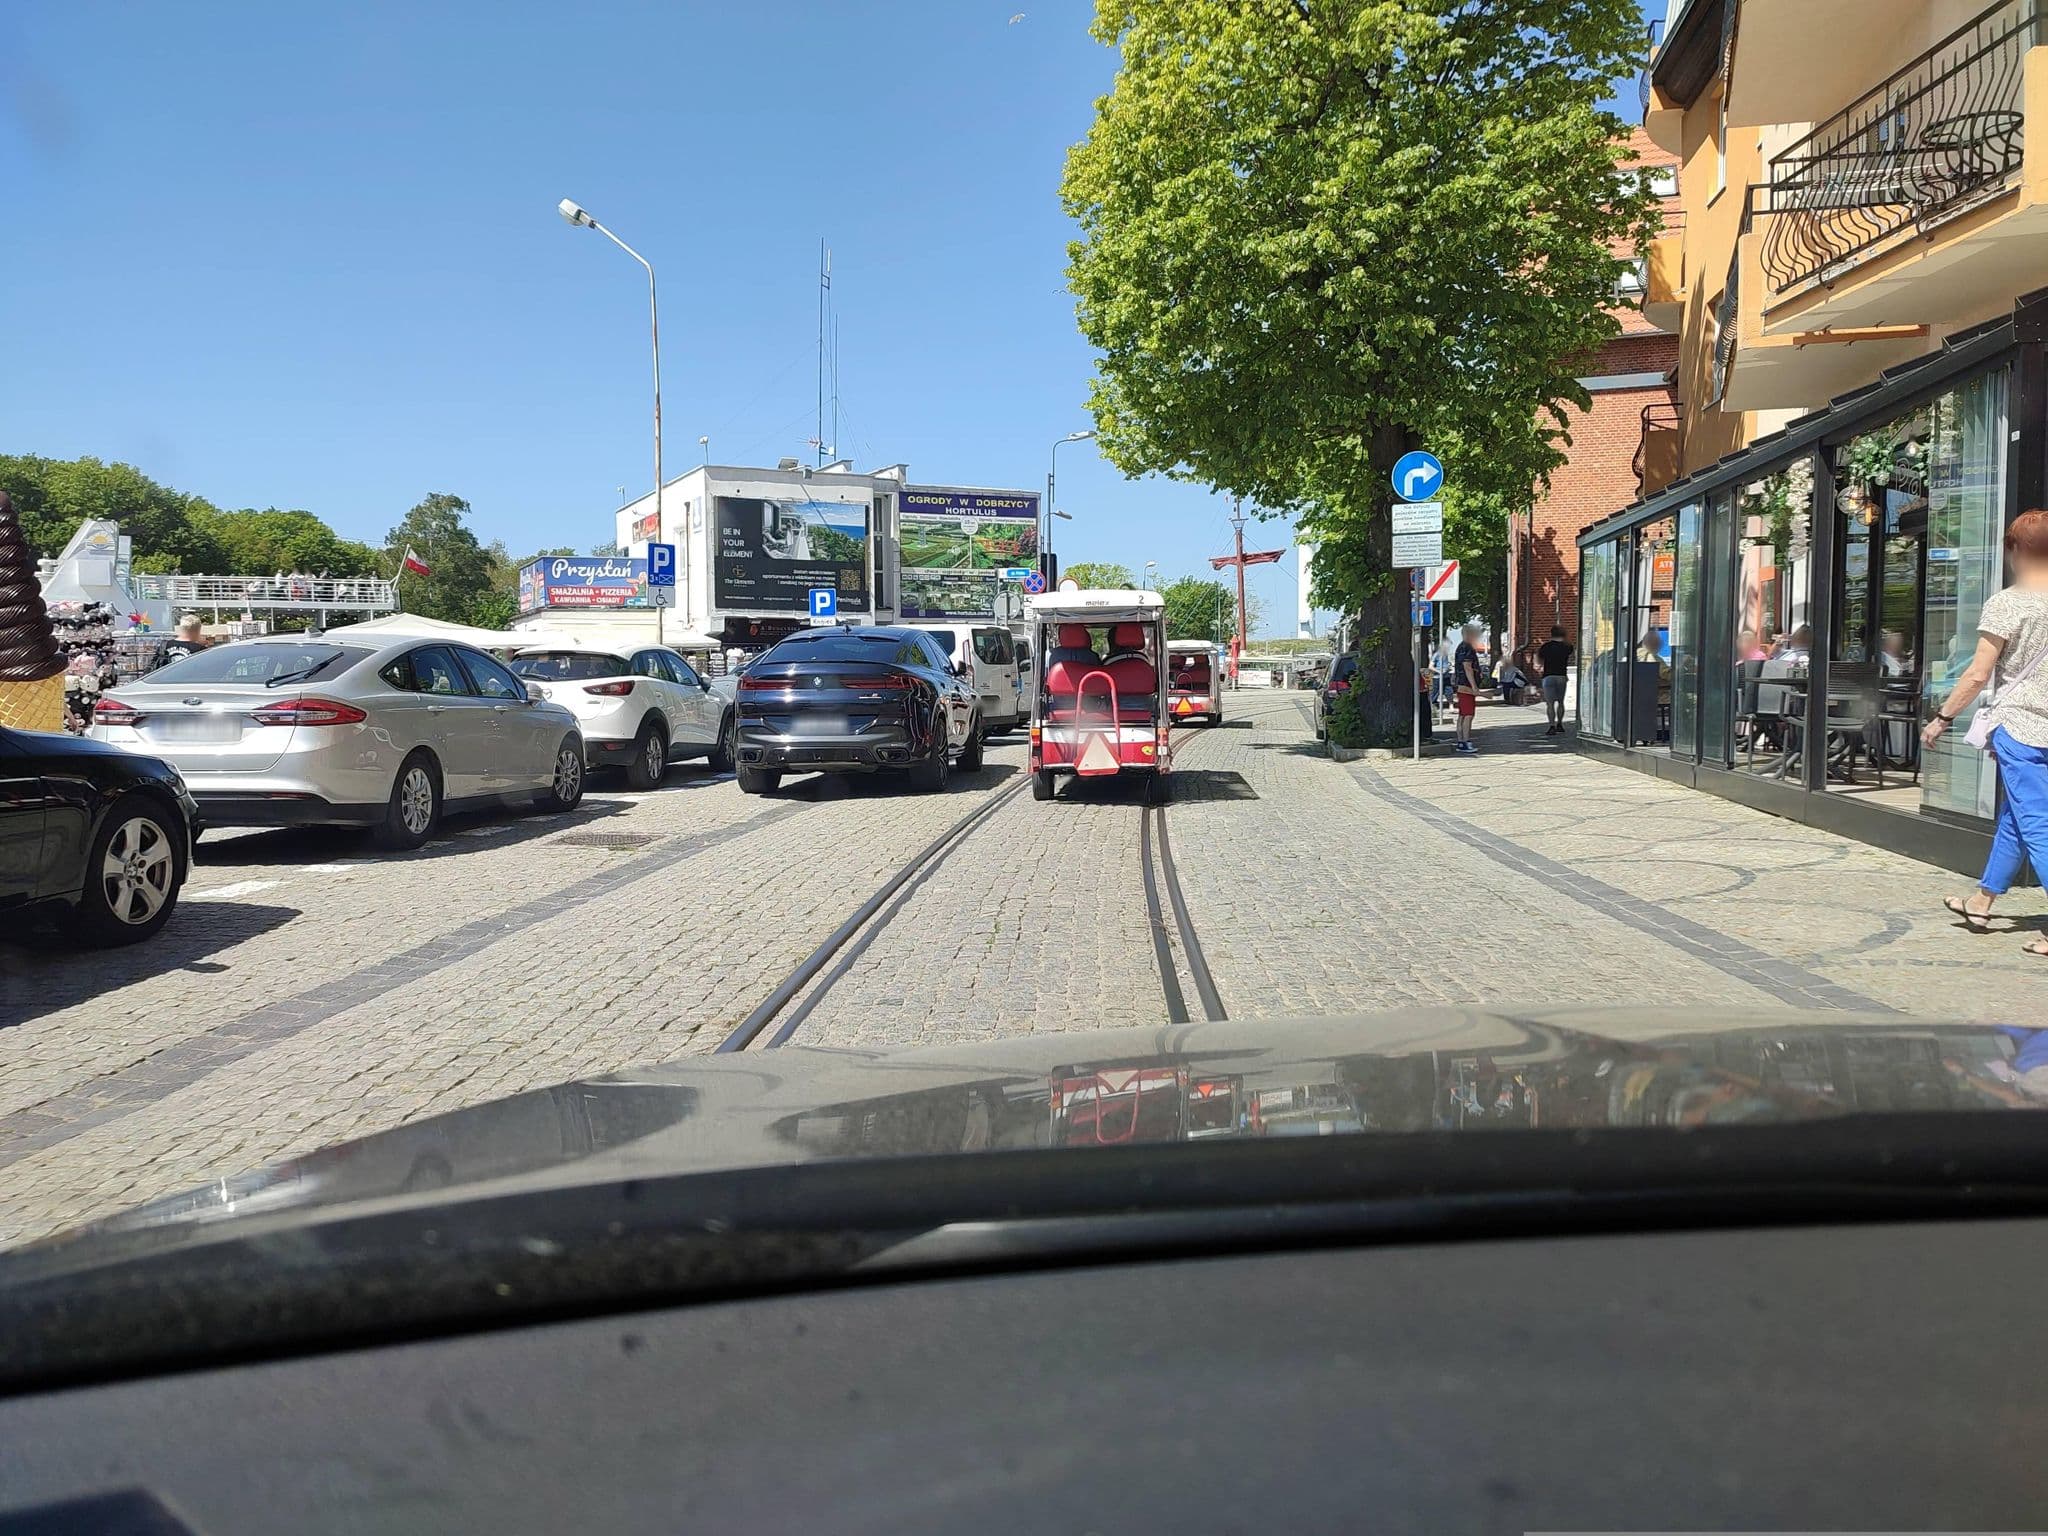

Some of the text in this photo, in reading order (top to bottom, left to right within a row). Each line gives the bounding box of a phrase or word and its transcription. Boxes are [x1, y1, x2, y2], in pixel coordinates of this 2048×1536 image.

[907, 495, 1030, 508] OGRODY W DOBRZYCY
[945, 508, 998, 517] HORTULUS
[723, 528, 741, 536] BE IN
[723, 538, 744, 547] YOUR
[723, 550, 753, 559] ELEMENT
[654, 547, 670, 573] P
[552, 558, 632, 585] Przystań
[550, 587, 633, 597] SMAŻALNIA PIZZERIA
[554, 596, 592, 604] KAWIARNIA
[814, 592, 830, 614] P
[1138, 595, 1145, 604] 2
